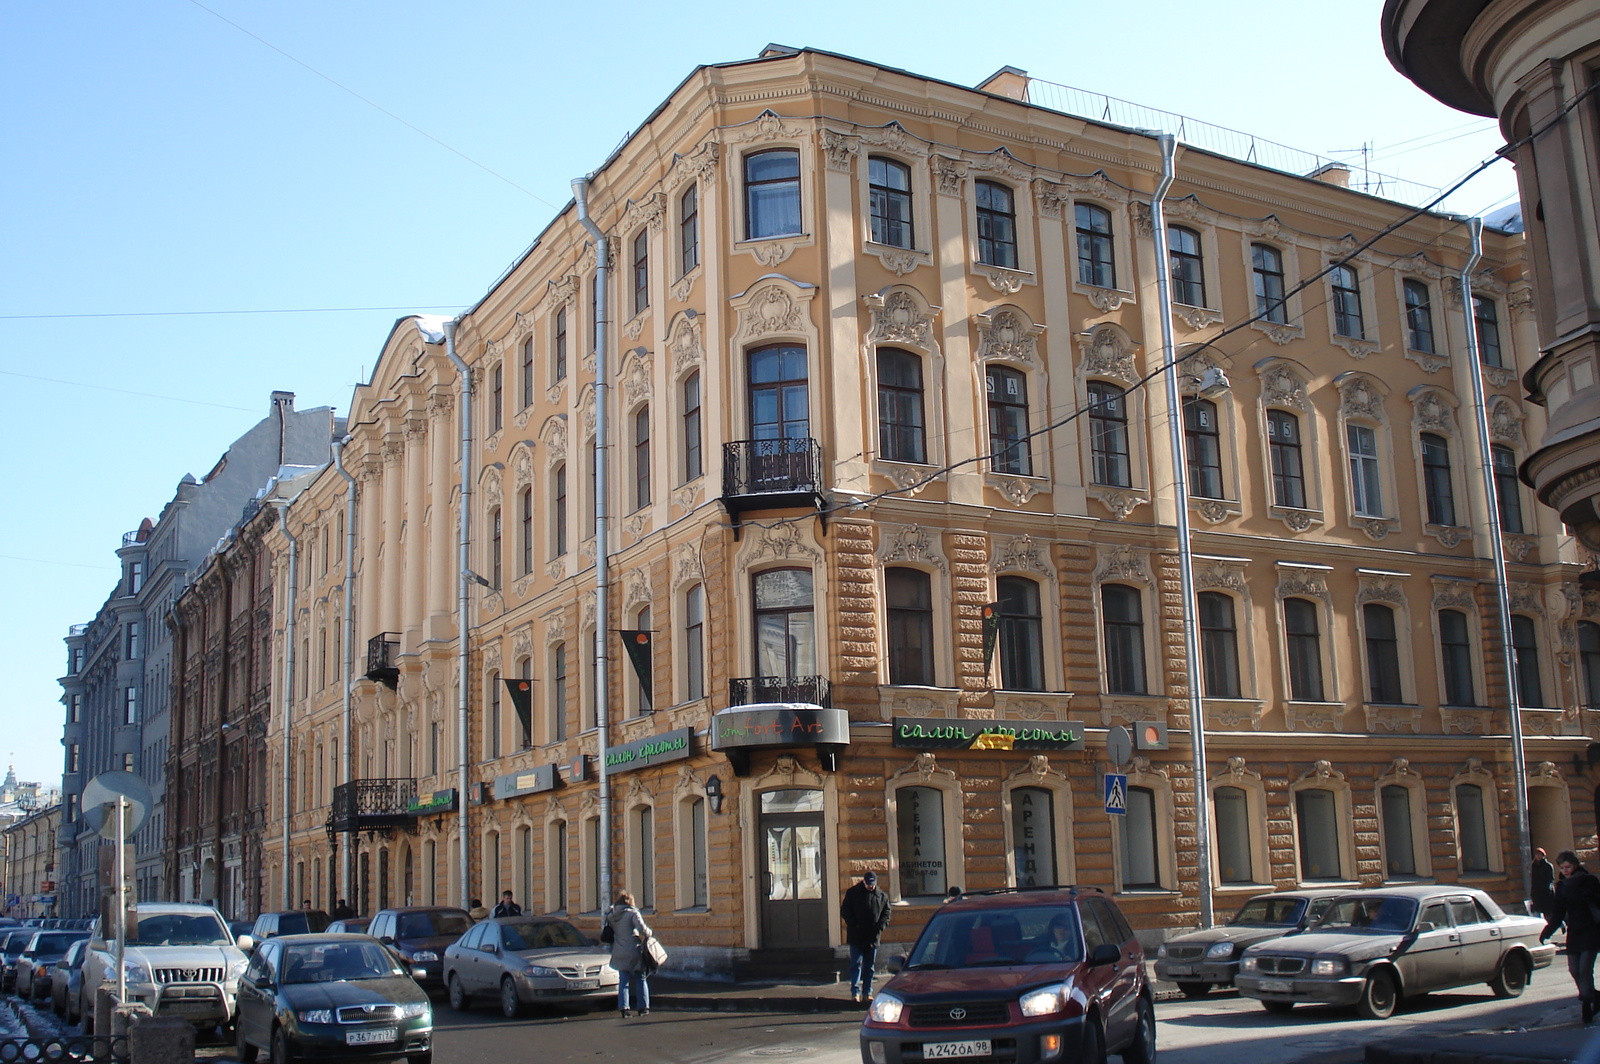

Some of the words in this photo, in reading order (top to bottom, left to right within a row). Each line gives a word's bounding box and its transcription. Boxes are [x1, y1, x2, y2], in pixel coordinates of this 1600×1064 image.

[791, 716, 824, 734] Art
[900, 724, 975, 739] салон
[911, 791, 922, 857] АРЕНДА
[928, 1043, 973, 1057] А242ОА
[975, 1041, 988, 1051] 98
